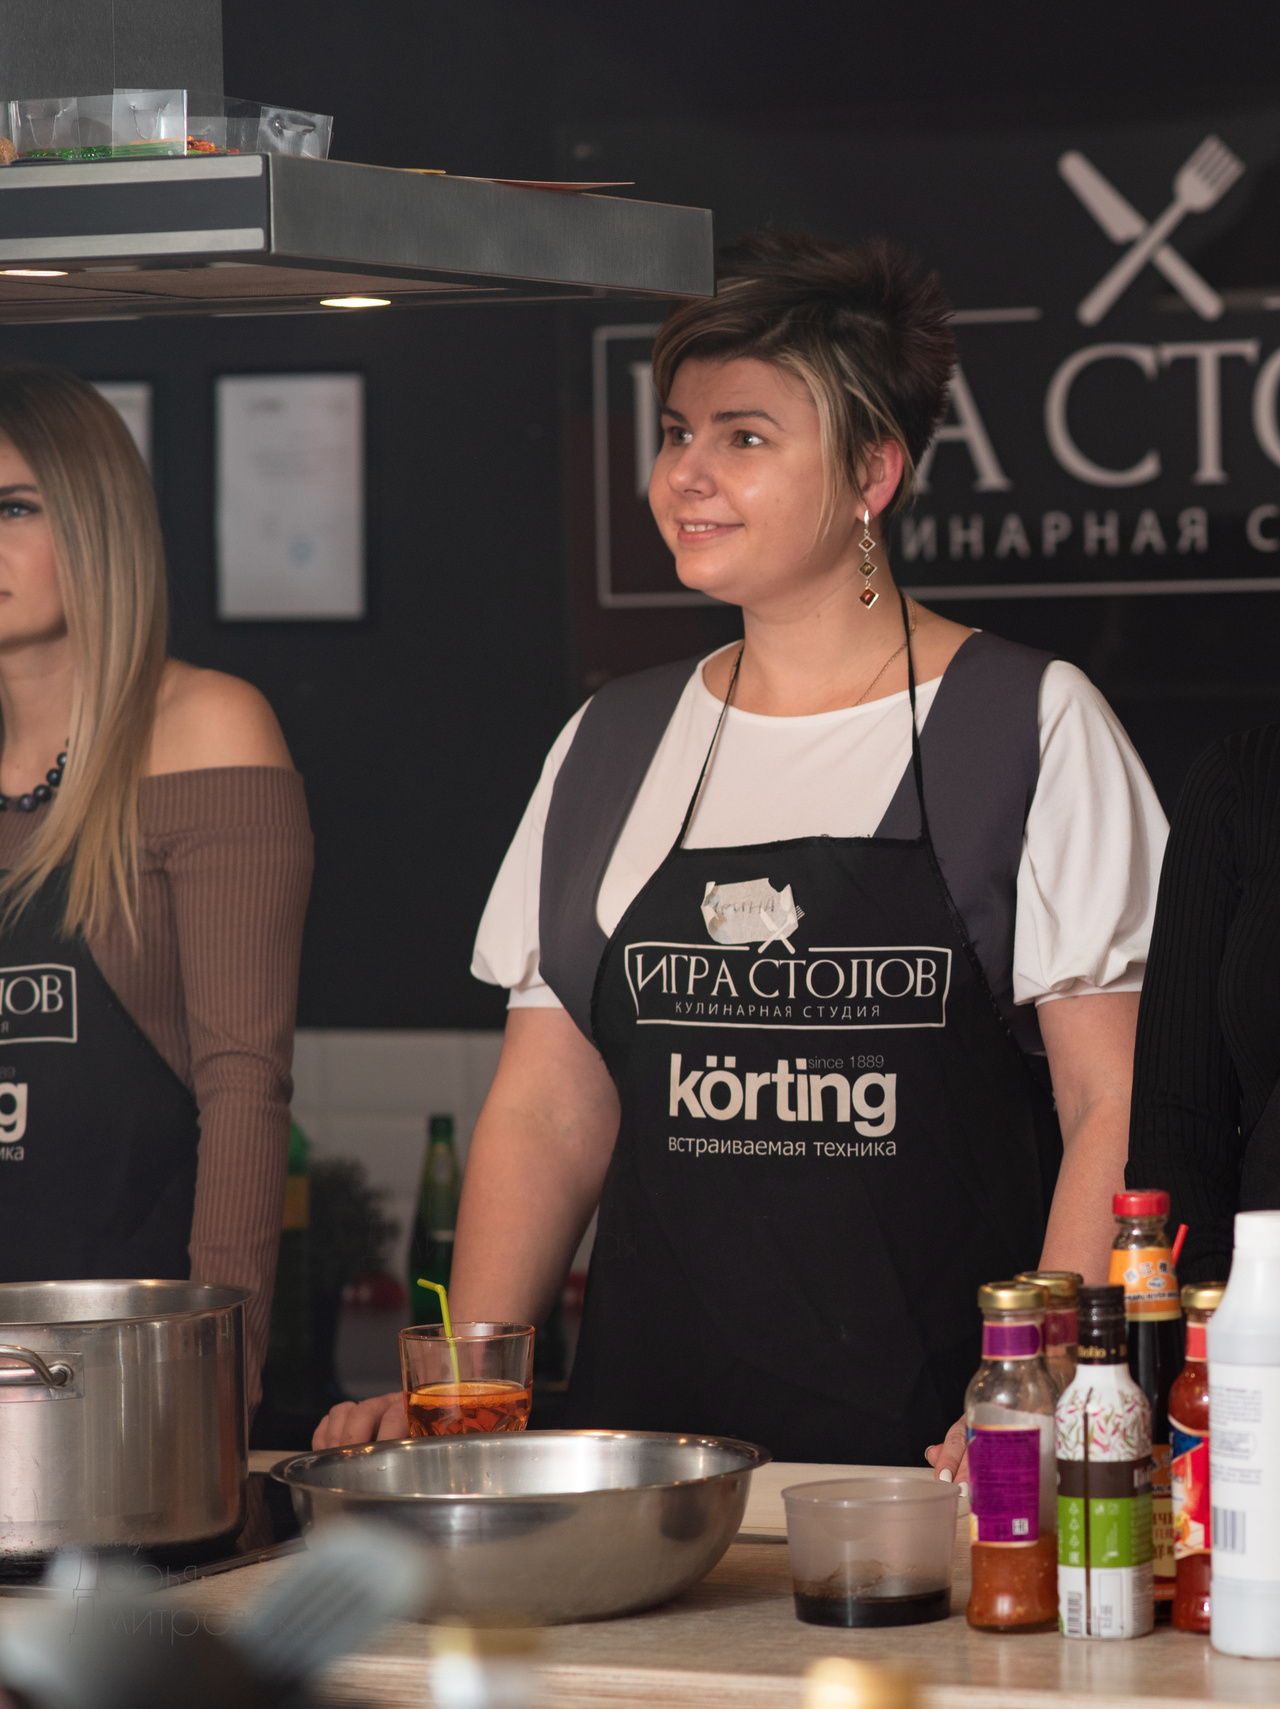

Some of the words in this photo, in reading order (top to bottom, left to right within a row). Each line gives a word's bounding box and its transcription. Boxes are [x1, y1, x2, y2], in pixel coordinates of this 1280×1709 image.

[901, 507, 1209, 559] ИНАРНАЯ
[636, 954, 739, 998] ИГРА
[749, 957, 938, 999] СТОЛОВ
[675, 1001, 793, 1018] КУЛИНАРНАЯ
[803, 1005, 881, 1020] СТУДИЯ
[808, 1056, 844, 1070] since
[850, 1055, 885, 1070] 1889
[669, 1053, 897, 1138] körting
[669, 1136, 806, 1157] встраиваемая
[813, 1140, 897, 1157] техника
